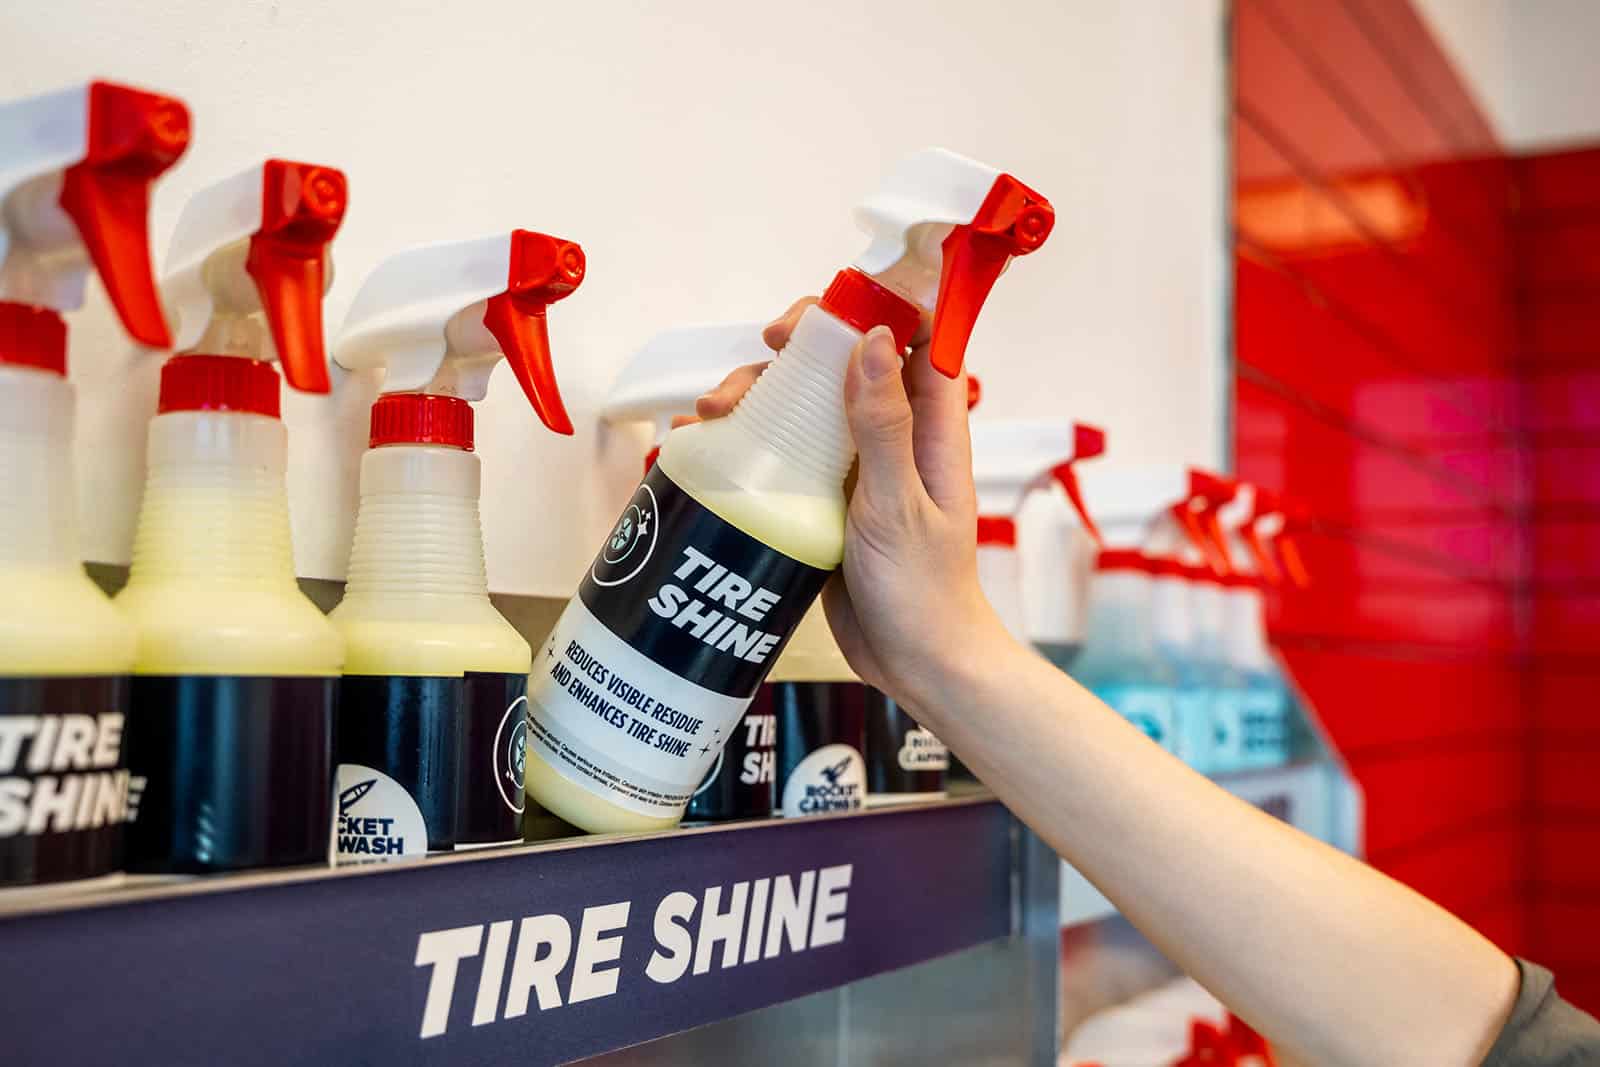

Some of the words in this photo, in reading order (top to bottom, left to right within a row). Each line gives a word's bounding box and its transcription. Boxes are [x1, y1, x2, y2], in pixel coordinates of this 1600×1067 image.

[673, 545, 782, 622] TIRE
[647, 584, 782, 664] SHINE
[550, 661, 571, 687] AND
[567, 676, 629, 730] ENHANCES
[626, 717, 657, 746] TIRE
[653, 731, 693, 759] SHINE
[565, 640, 610, 685] REDUCES
[607, 673, 655, 715] VISIBLE
[651, 703, 704, 736] RESIDUE
[0, 711, 125, 773] TIRE
[337, 835, 405, 856] WASH
[413, 900, 632, 1040] TIRE
[644, 863, 854, 984] SHINE
